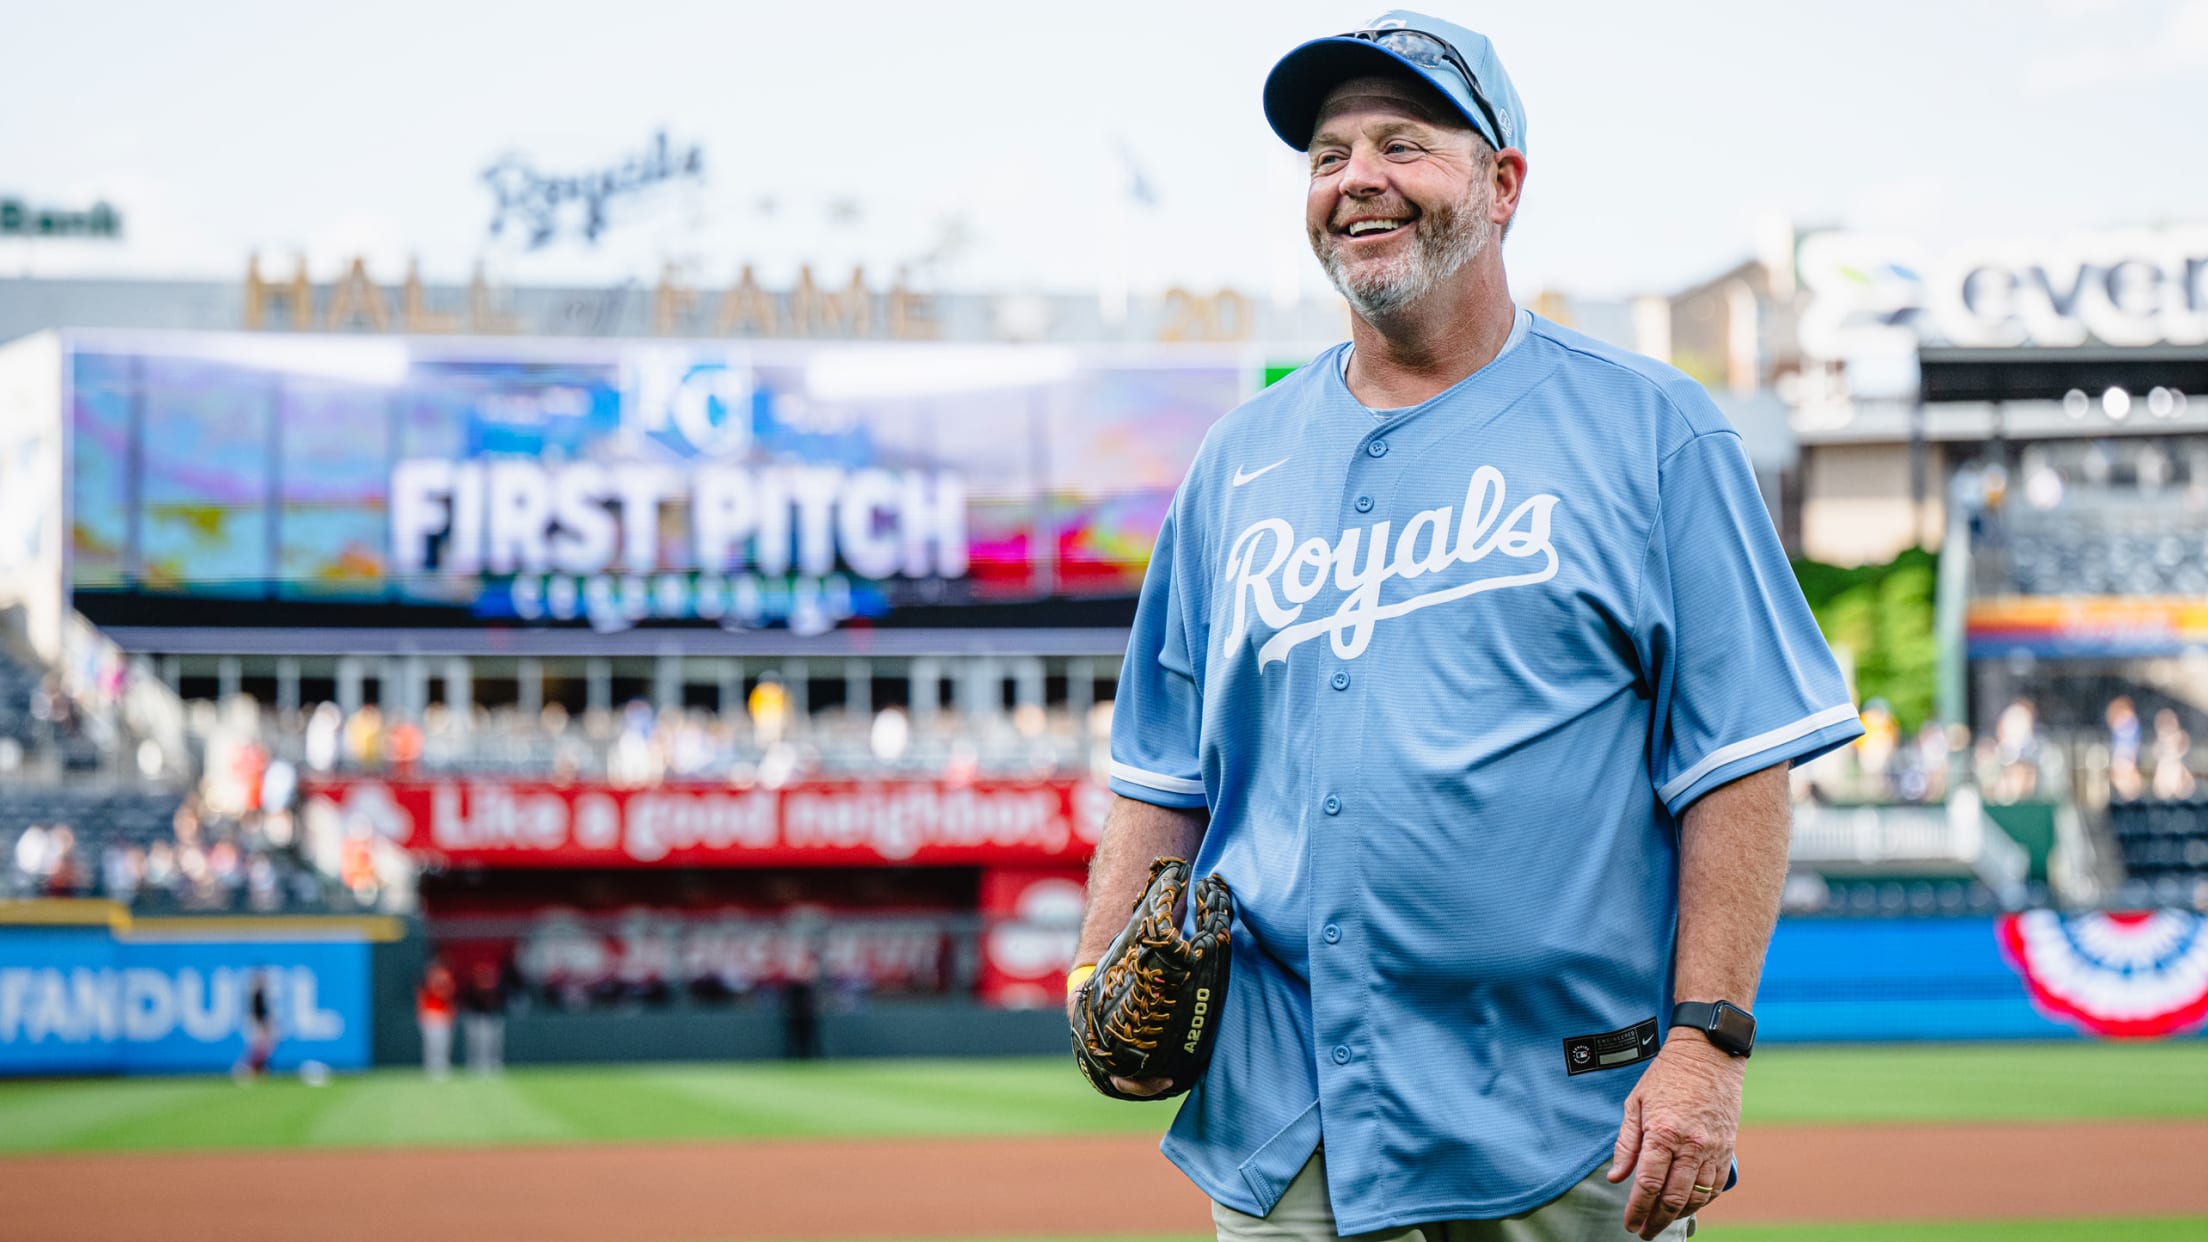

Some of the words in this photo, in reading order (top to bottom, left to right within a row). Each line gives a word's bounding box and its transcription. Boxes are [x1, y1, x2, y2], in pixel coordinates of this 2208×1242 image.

[246, 256, 518, 331] HALL
[654, 262, 942, 339] FAME
[393, 460, 675, 578] FIRST
[692, 466, 968, 580] PITCH
[1224, 465, 1560, 675] Royals
[432, 785, 568, 849] Like
[577, 794, 620, 849] a
[623, 785, 779, 861] good
[1185, 988, 1210, 1054] A2000
